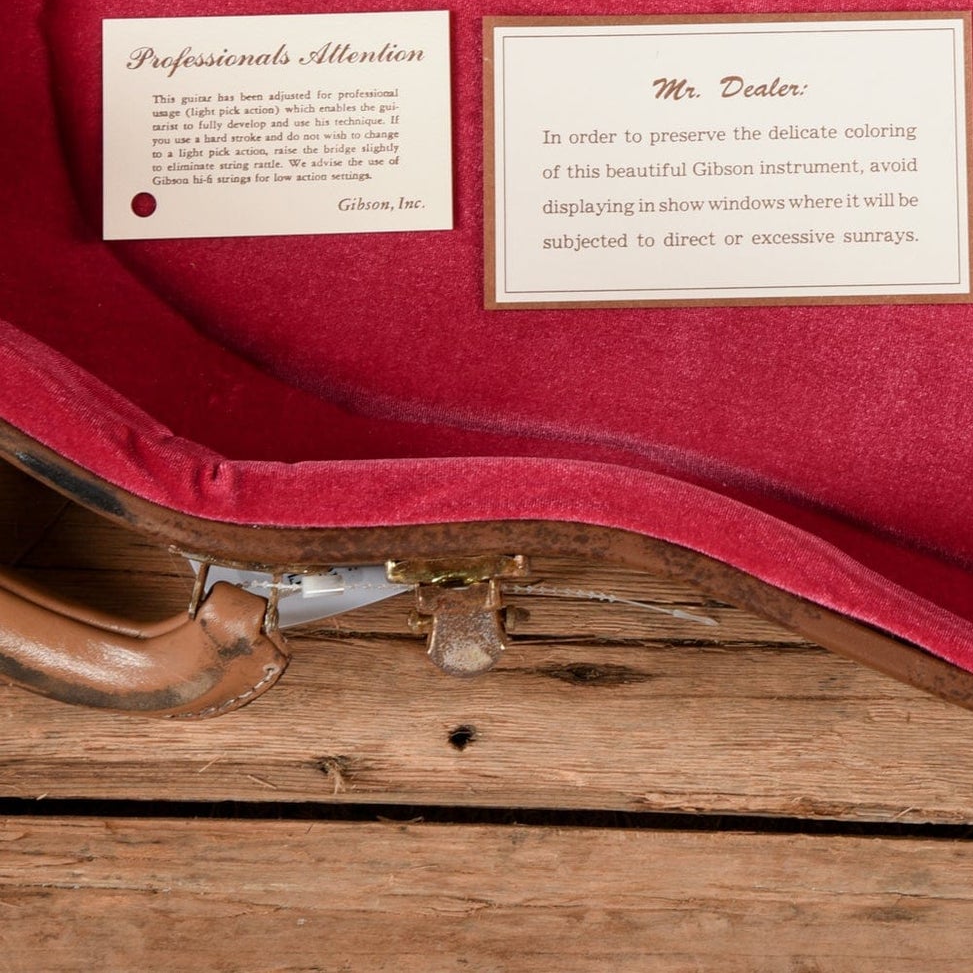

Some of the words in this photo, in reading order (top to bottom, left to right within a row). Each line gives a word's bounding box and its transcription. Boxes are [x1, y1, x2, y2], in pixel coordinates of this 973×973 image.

[125, 43, 291, 78] Professionals
[298, 41, 425, 65] Attention
[151, 93, 175, 104] This
[180, 93, 212, 106] guitar
[217, 92, 234, 103] has
[240, 91, 263, 102] been
[268, 89, 311, 102] adjusted
[316, 89, 332, 100] for
[337, 87, 398, 102] professional
[652, 77, 701, 101] Mr.
[719, 75, 808, 98] Dealer:
[542, 129, 562, 145] In
[568, 129, 618, 146] order
[623, 129, 643, 146] to
[649, 130, 727, 147] preserve
[732, 125, 762, 141] the
[767, 124, 839, 140] delicate
[843, 122, 918, 141] coloring
[151, 175, 189, 186] Gibson
[192, 173, 213, 184] hi-fi
[216, 173, 251, 185] strings
[254, 172, 270, 183] for
[273, 172, 292, 182] low
[295, 170, 327, 182] action
[330, 170, 372, 182] settings.
[542, 164, 562, 179] of
[566, 163, 601, 179] this
[605, 161, 687, 179] beautiful
[692, 161, 755, 177] Gibson
[759, 159, 864, 175] instrument,
[869, 157, 918, 173] avoid
[337, 196, 395, 212] Gibson,
[398, 196, 425, 210] Inc.
[542, 197, 636, 217] displaying
[638, 197, 656, 213] in
[658, 197, 705, 213] show
[707, 195, 786, 211] windows
[786, 193, 843, 209] where
[846, 193, 861, 208] it
[862, 192, 895, 209] will
[898, 192, 919, 207] be
[542, 232, 629, 252] subjected
[636, 233, 656, 248] to
[663, 231, 717, 248] direct
[723, 234, 744, 246] or
[751, 227, 835, 245] excessive
[842, 230, 919, 245] sunrays.
